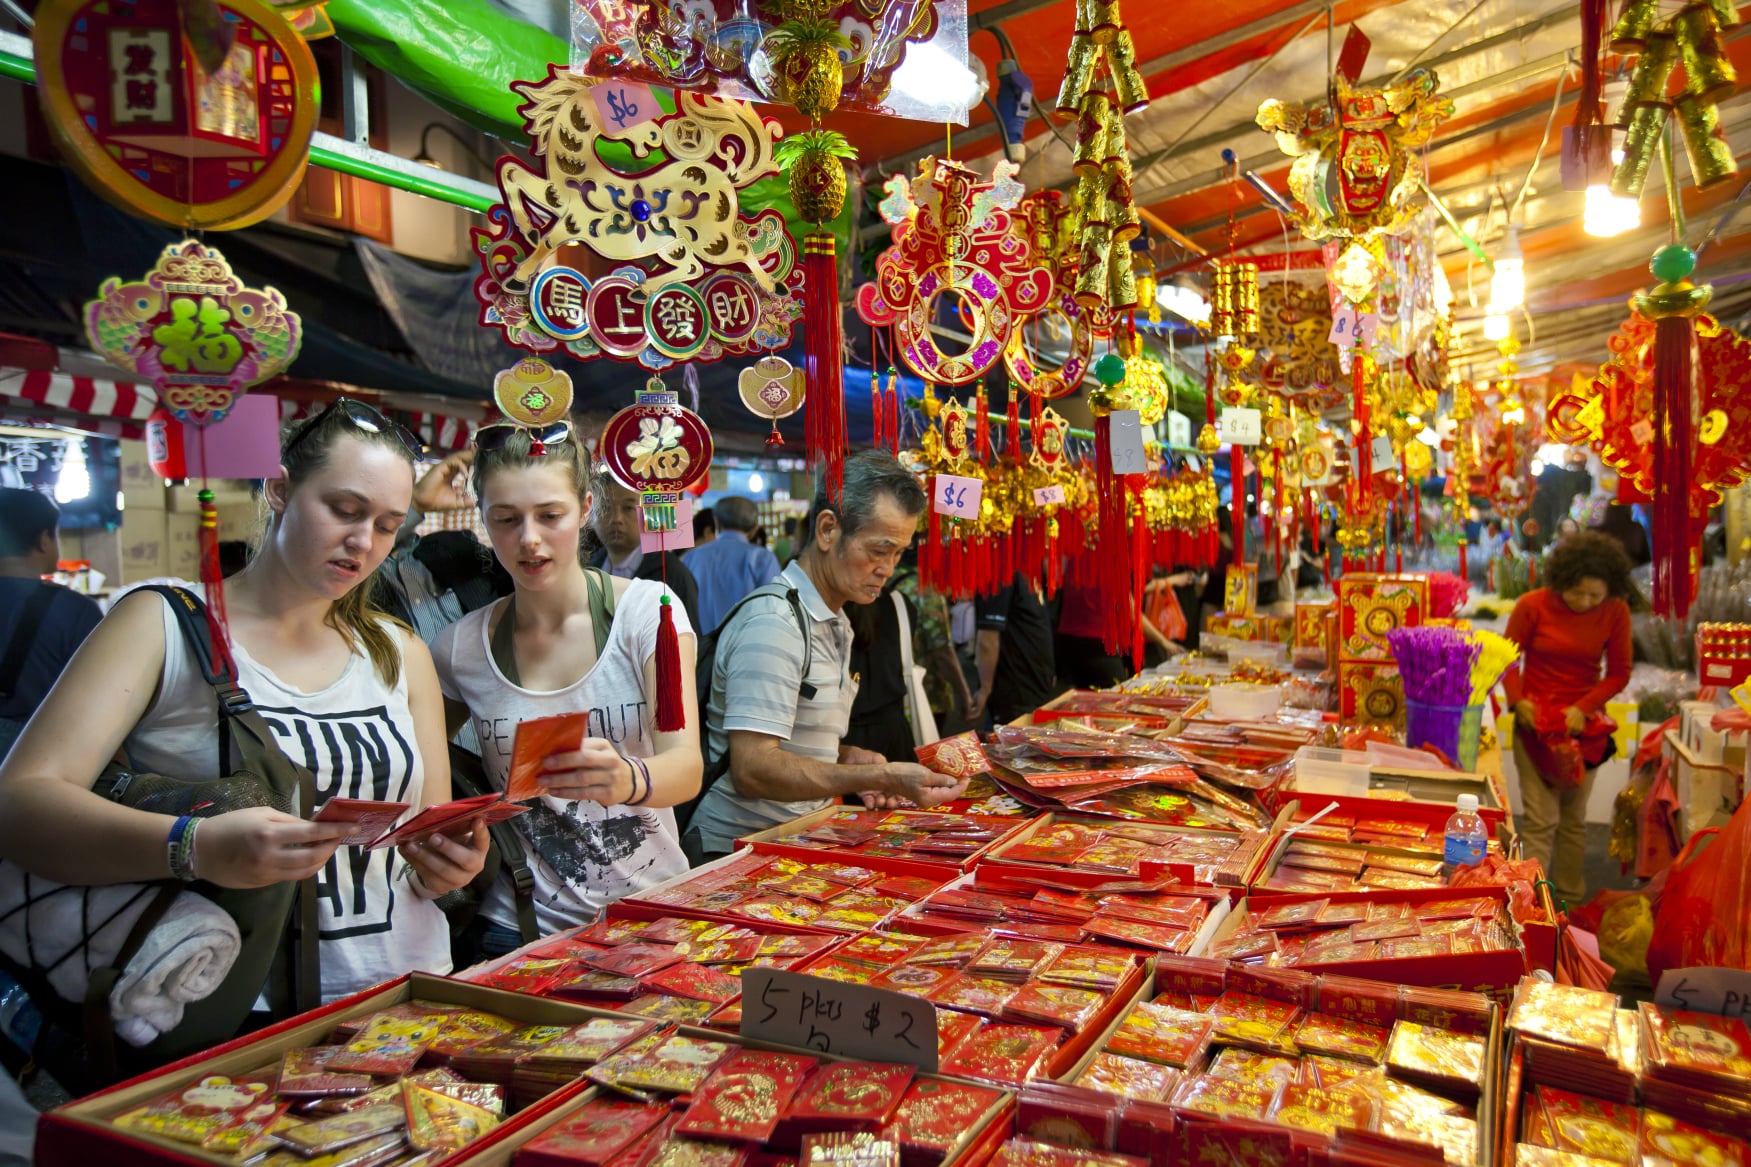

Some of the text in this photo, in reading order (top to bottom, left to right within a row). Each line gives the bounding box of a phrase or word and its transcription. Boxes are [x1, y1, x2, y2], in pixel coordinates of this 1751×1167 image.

[606, 89, 638, 128] $6
[547, 278, 750, 340] 馬上發財
[153, 298, 243, 373] 福
[527, 392, 546, 409] 福
[765, 387, 782, 403] 福
[625, 415, 691, 480] 福
[944, 482, 967, 508] $6
[263, 716, 391, 806] UN
[760, 978, 790, 1024] 5
